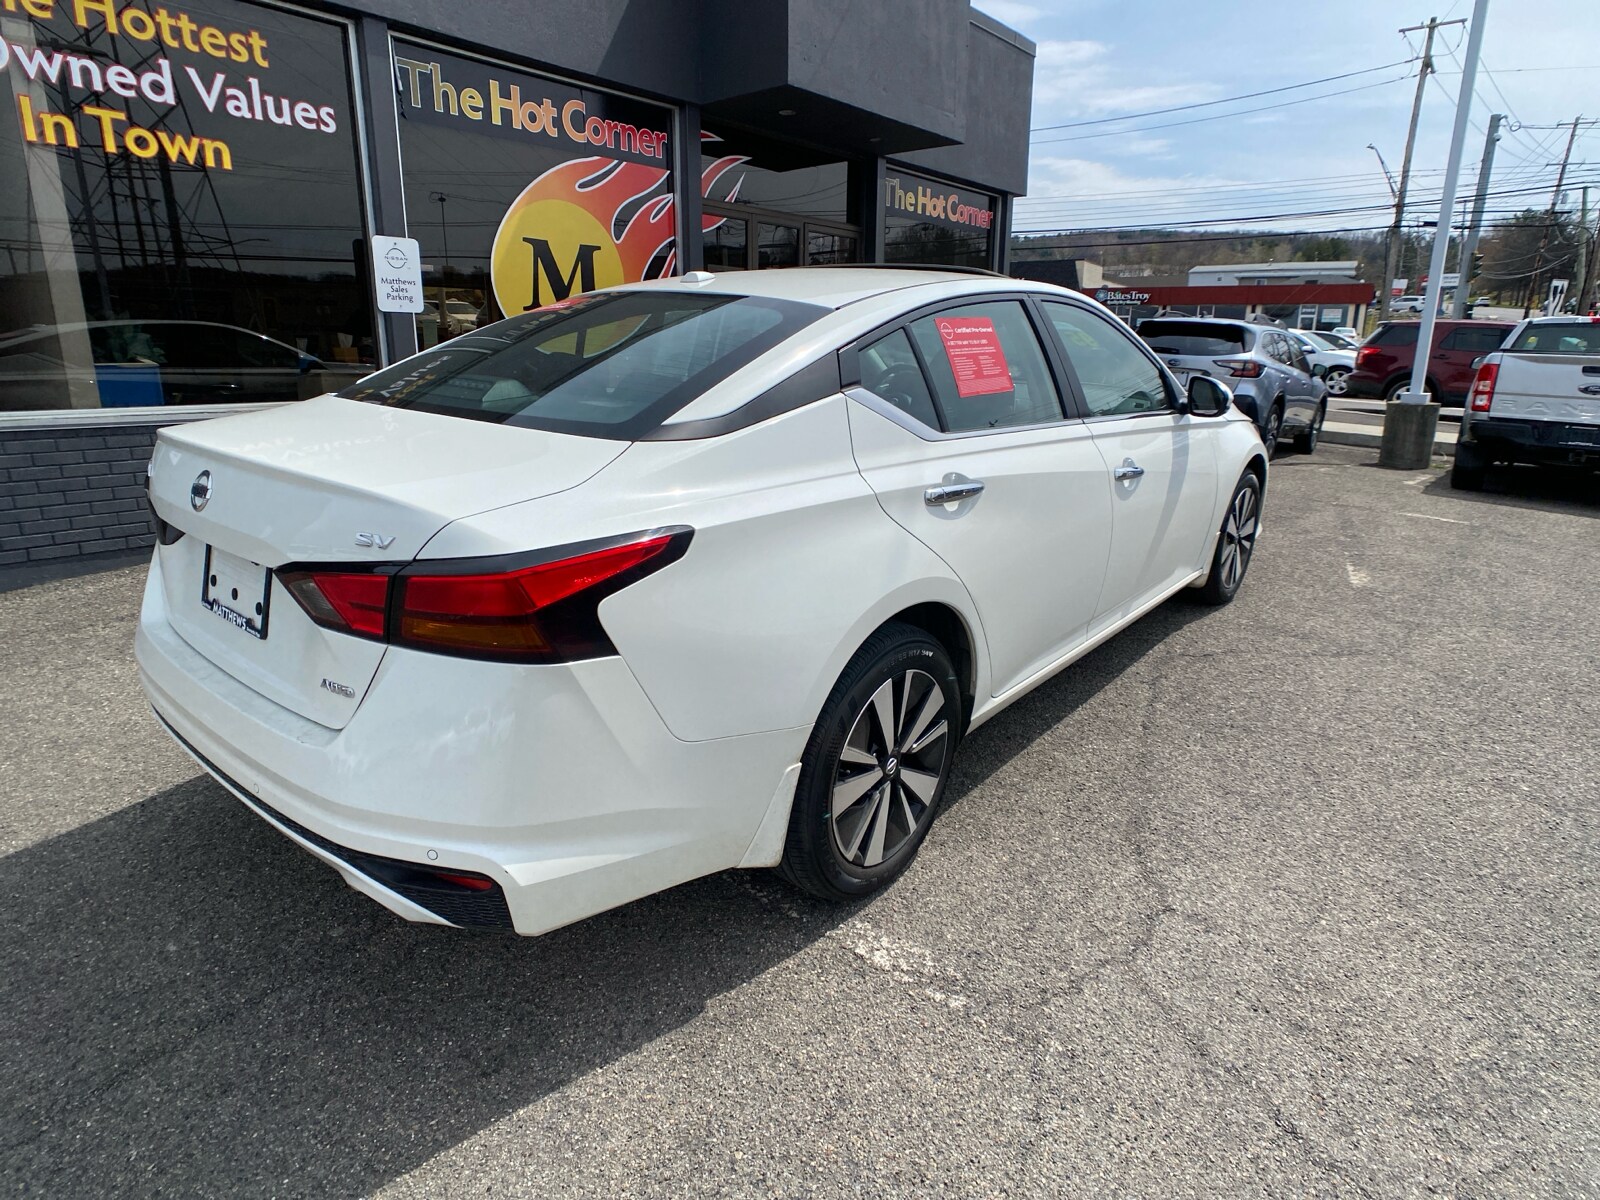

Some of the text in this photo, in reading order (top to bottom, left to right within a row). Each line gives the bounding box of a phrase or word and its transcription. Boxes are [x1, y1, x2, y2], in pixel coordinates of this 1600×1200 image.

[73, 0, 269, 68] Hottest
[0, 34, 337, 133] wned Values
[395, 56, 667, 158] The Hot Corner
[17, 93, 233, 171] In Town
[885, 178, 993, 229] The Hot Corner
[381, 278, 416, 286] Matthews
[387, 293, 414, 303] Parking
[522, 236, 602, 311] M
[355, 532, 396, 550] SV
[212, 602, 247, 630] MATTHEWS
